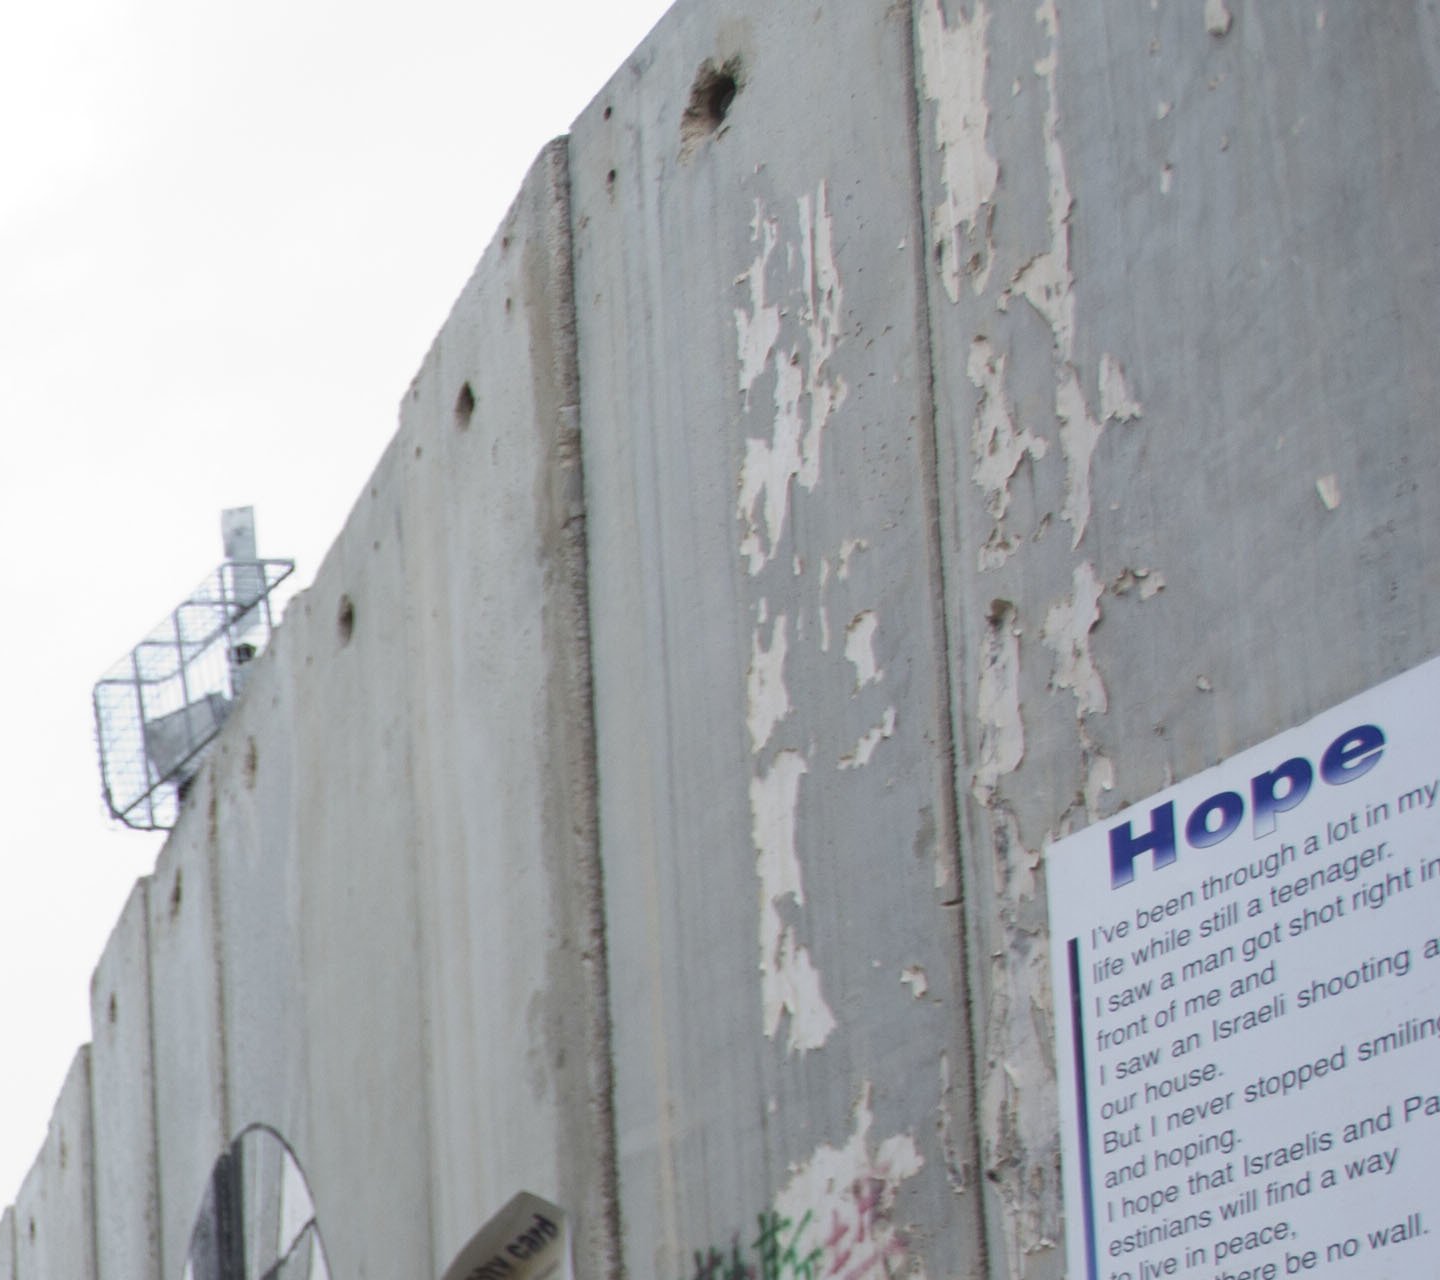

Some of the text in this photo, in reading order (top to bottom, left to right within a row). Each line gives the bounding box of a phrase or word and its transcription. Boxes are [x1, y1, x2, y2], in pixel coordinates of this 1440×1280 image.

[1108, 723, 1387, 891] Hope
[1091, 780, 1439, 951] I've been through a lot in my
[1093, 841, 1394, 984] life while still a teenager.
[1095, 996, 1101, 1018] I
[1108, 979, 1153, 1012] saw
[1160, 971, 1175, 990] a
[1182, 947, 1234, 982] man
[1242, 922, 1282, 962] got
[1289, 896, 1345, 937] shot
[1352, 867, 1413, 910] right
[1096, 960, 1276, 1051] front of me and
[1099, 1064, 1105, 1086] I
[1115, 1048, 1160, 1079] saw
[1171, 1033, 1200, 1058] an
[1213, 993, 1285, 1042] Israeli
[1297, 949, 1410, 1009] shooting
[1101, 1063, 1224, 1120] our house.
[1103, 1123, 1141, 1155] But
[1150, 1115, 1156, 1137] I
[1167, 1091, 1234, 1131] never
[1244, 1045, 1345, 1103] stopped
[1105, 1128, 1242, 1188] and hoping.
[1107, 1201, 1113, 1222] I
[1122, 1185, 1179, 1218] hope
[1188, 1162, 1234, 1195] that
[1244, 1131, 1333, 1177] Israelis
[1343, 1105, 1392, 1143] and
[1109, 1147, 1400, 1257] estinians will find a way
[1185, 1247, 1205, 1269] in
[1214, 1222, 1297, 1265] peace,
[1285, 1251, 1317, 1275] be
[1327, 1238, 1359, 1262] no
[1368, 1212, 1430, 1249] wall.
